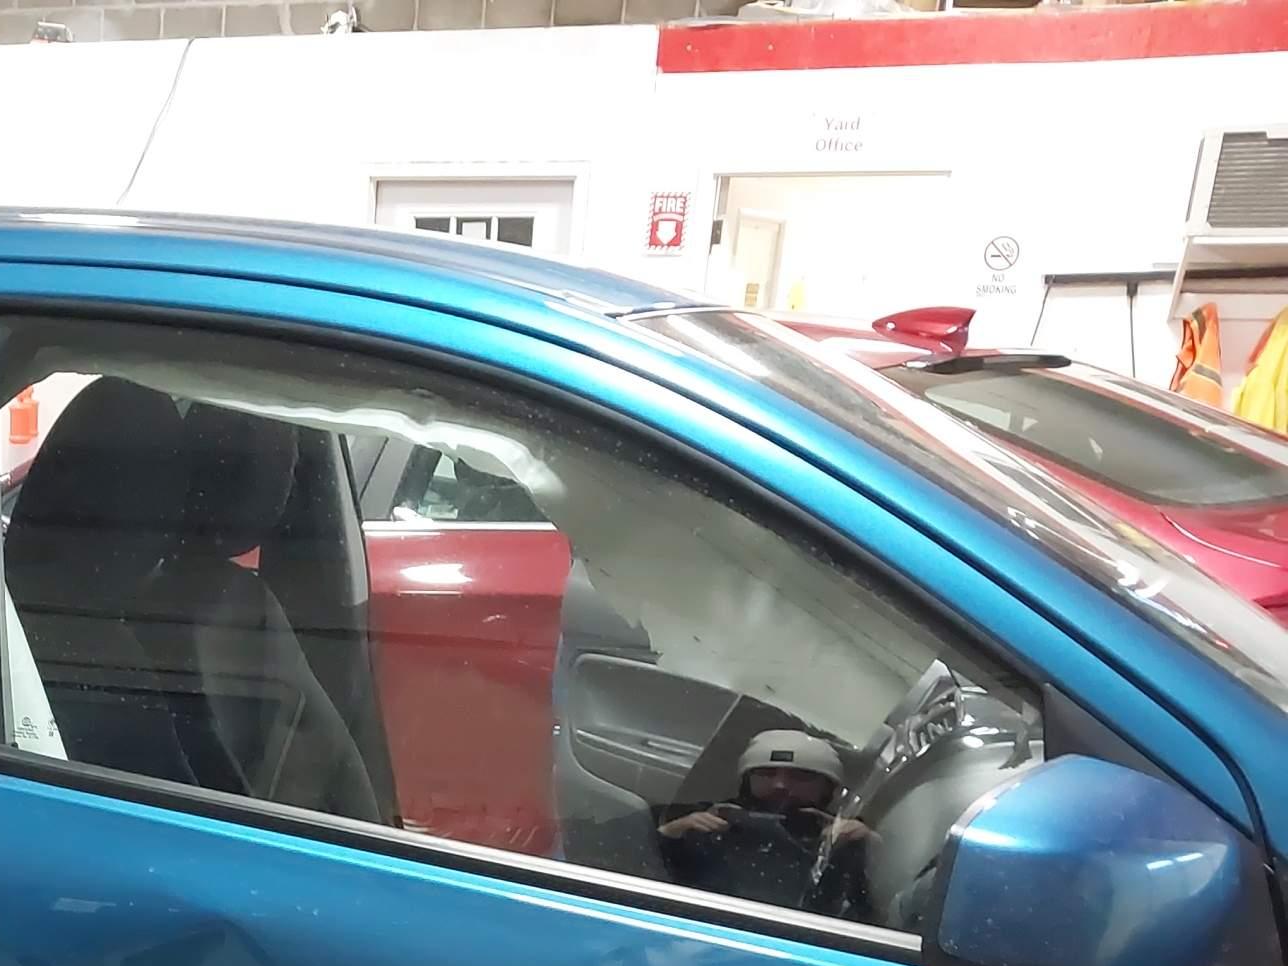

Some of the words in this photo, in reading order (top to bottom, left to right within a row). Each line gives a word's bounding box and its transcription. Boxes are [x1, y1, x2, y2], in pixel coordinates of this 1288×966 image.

[824, 116, 861, 131] Yard
[815, 137, 863, 152] Office
[654, 197, 685, 214] FIRE
[991, 273, 1005, 282] NO
[976, 284, 1017, 295] SMOKING
